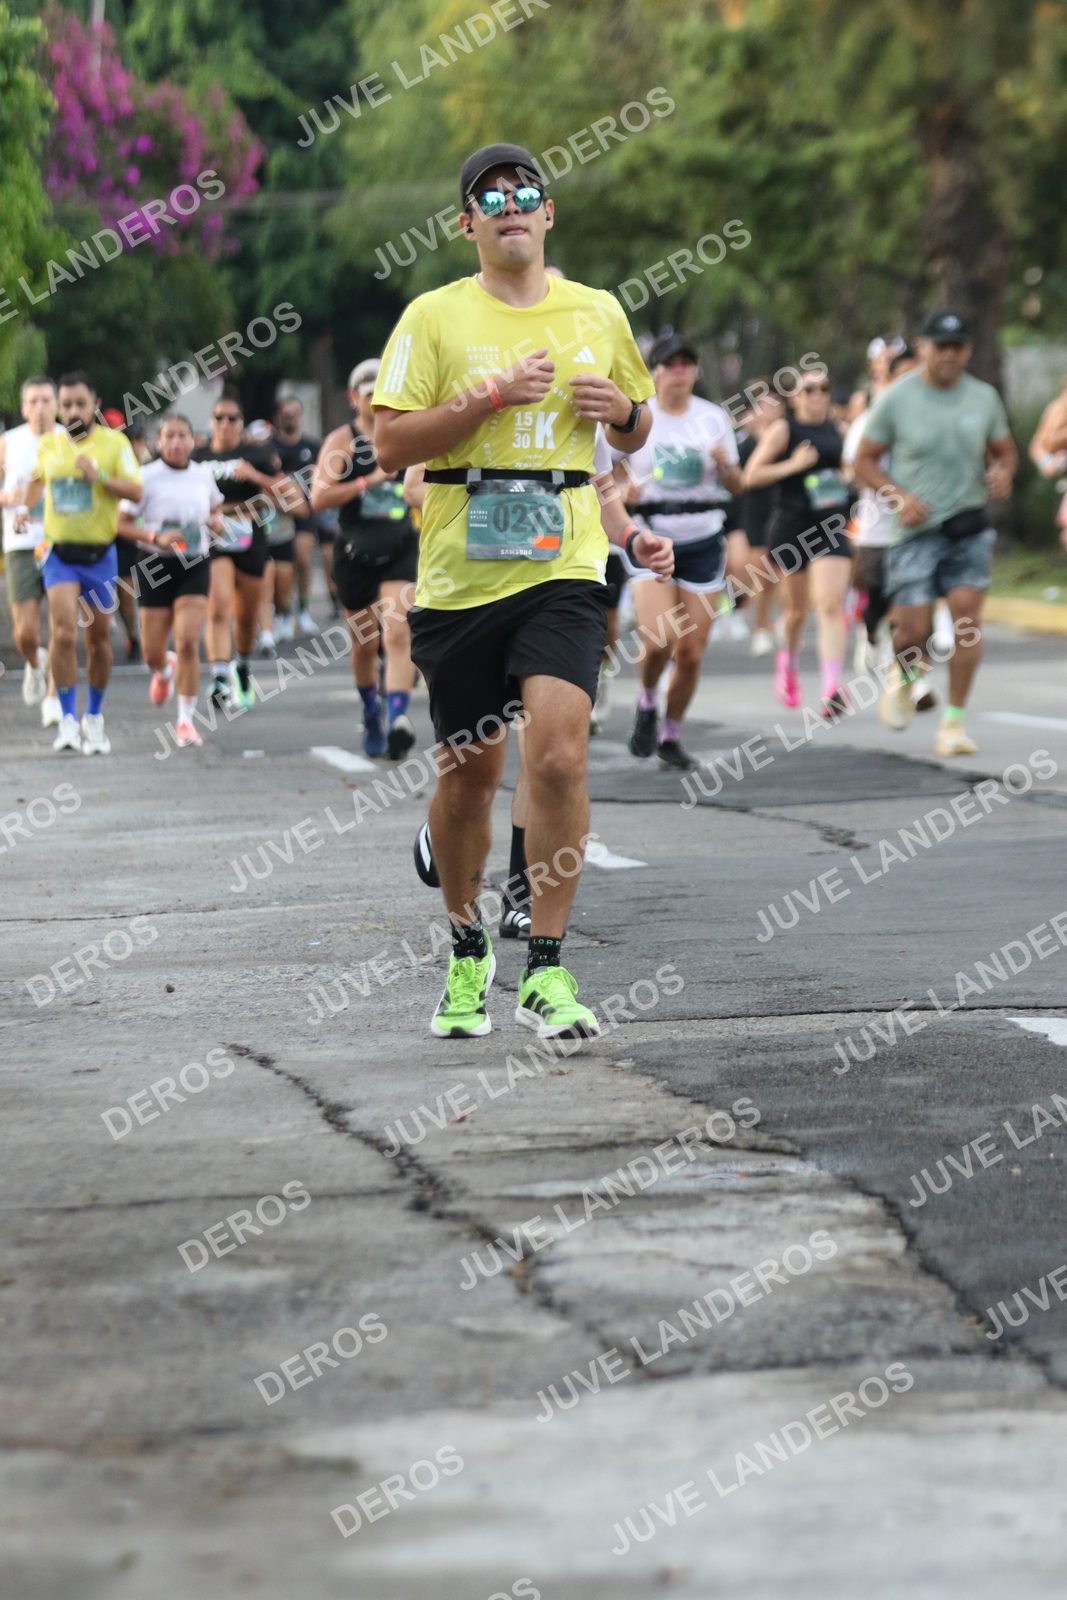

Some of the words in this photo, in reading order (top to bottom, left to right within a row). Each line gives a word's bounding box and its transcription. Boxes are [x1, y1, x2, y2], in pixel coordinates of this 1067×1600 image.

[514, 411, 533, 427] 15
[535, 411, 559, 449] K
[512, 433, 531, 449] 30
